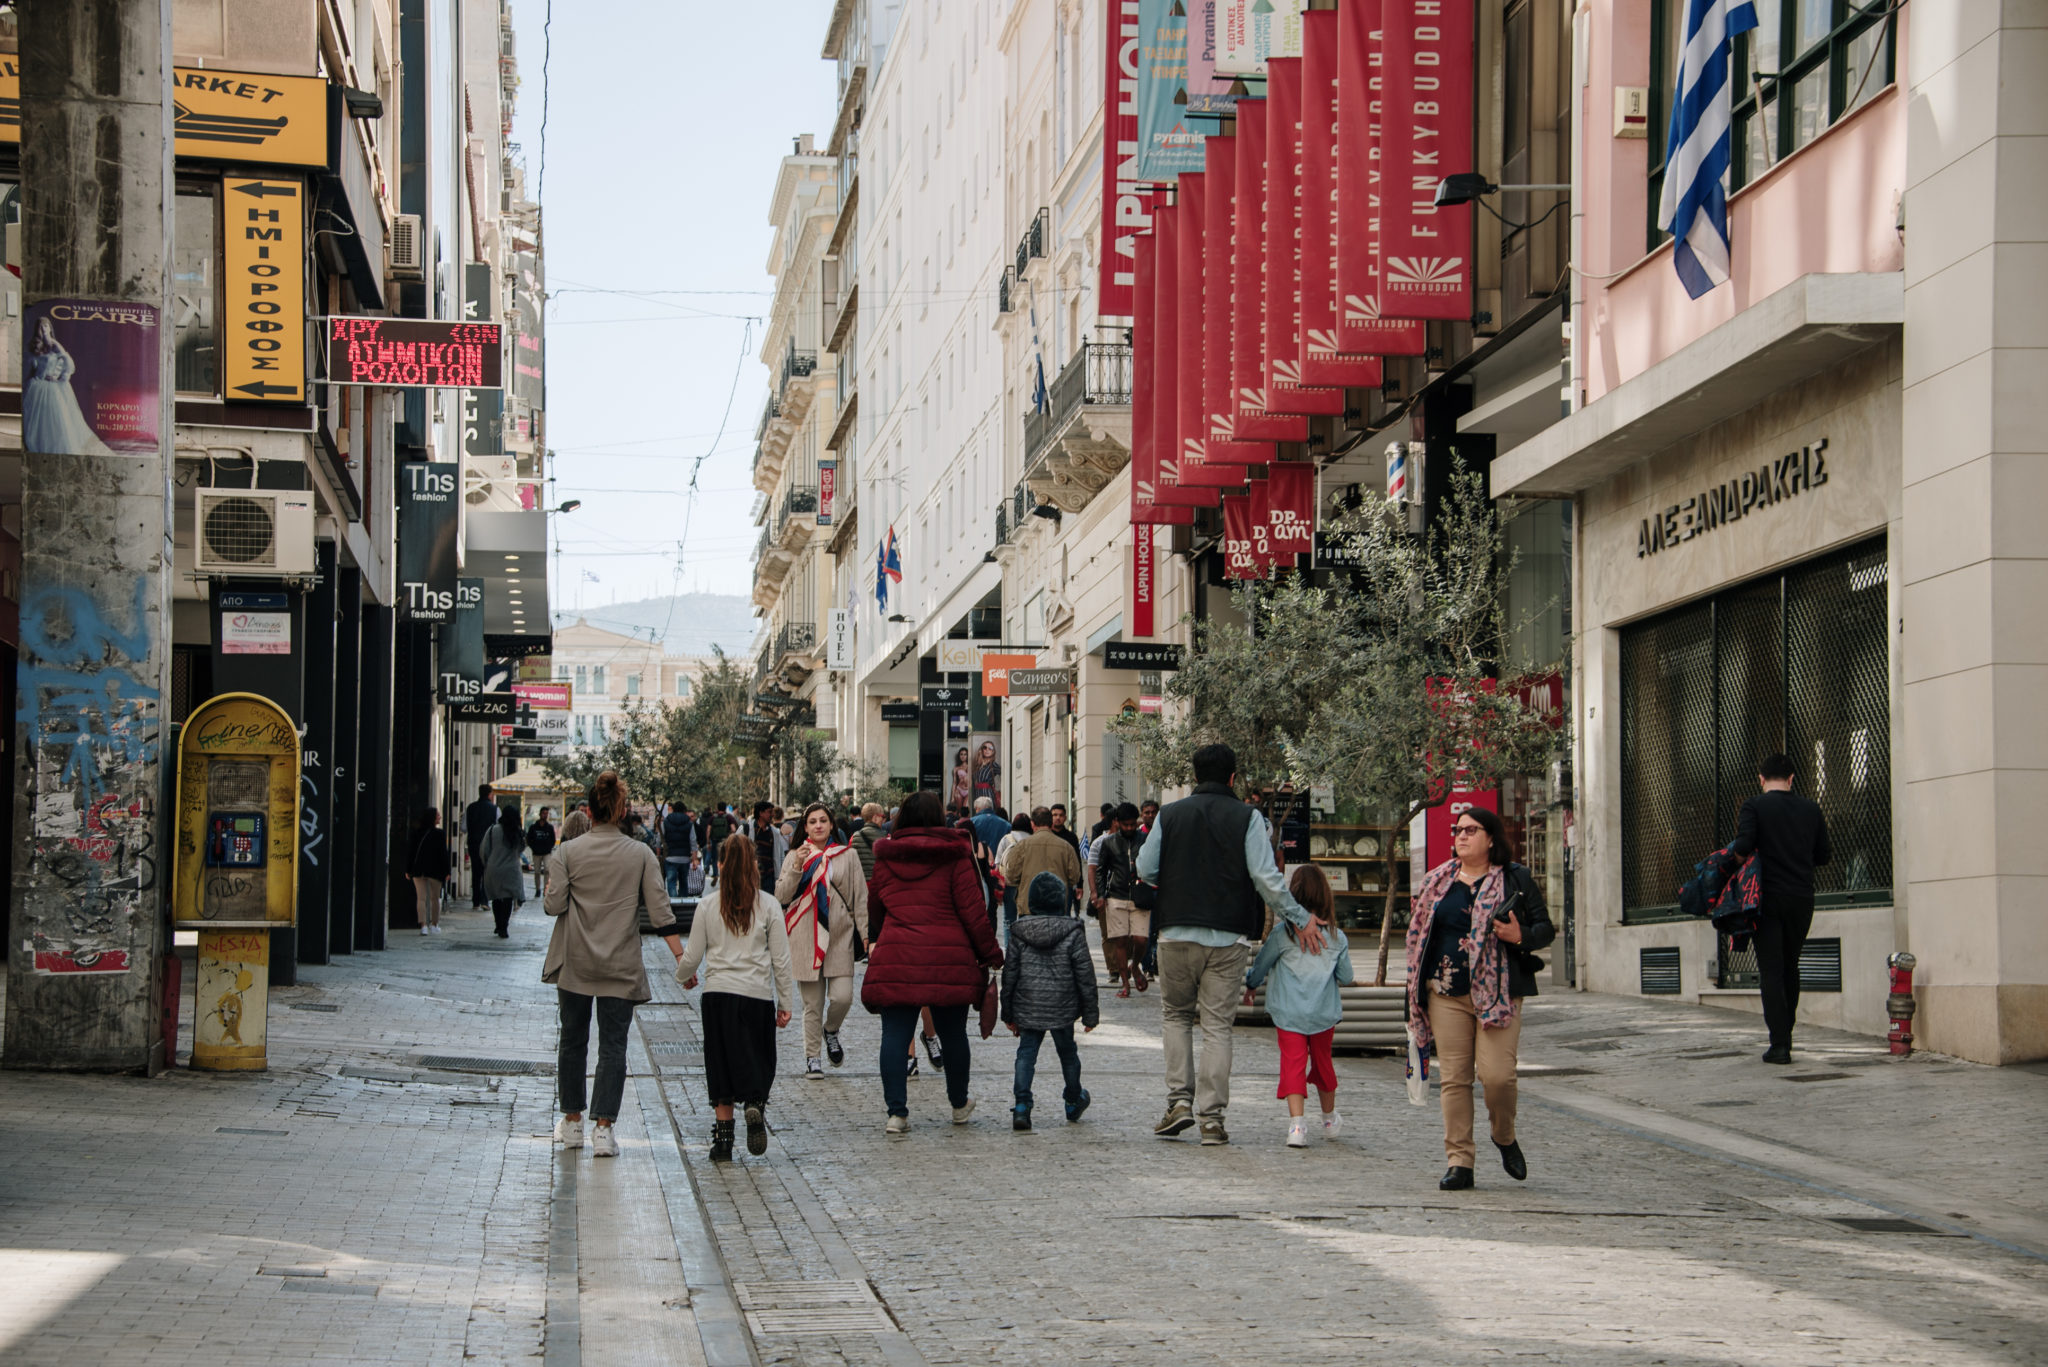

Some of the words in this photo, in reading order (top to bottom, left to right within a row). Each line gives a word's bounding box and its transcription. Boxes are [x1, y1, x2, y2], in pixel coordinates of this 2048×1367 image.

[1202, 1, 1216, 61] Pyramis
[1228, 6, 1236, 52] ΕΞΩΤΙΚΕΣ
[1263, 15, 1271, 59] ΙΝΗΤΡΩΝ
[174, 74, 284, 104] RKET
[246, 207, 283, 371] ΗΜΙΟΡΟΦΟΣ
[1387, 282, 1462, 292] FUNKYBUDDHA
[50, 305, 157, 327] CLAIRE
[351, 361, 482, 387] ΡΟΛΟΓΙΩΝ
[405, 465, 455, 493] Ths
[412, 492, 448, 502] fashion
[1637, 438, 1829, 559] ΑΛΕΞΑΝΔΡΑΚΗΣ
[1138, 523, 1150, 565] HOUSE
[1274, 524, 1311, 540] am
[403, 582, 454, 610] Ths
[457, 580, 481, 602] hs
[1138, 566, 1150, 603] LAPIN
[411, 609, 446, 620] fashion
[836, 612, 845, 662] HOTEL
[440, 672, 481, 696] Ths
[1010, 670, 1068, 686] Cameo's
[446, 694, 475, 702] fashion
[483, 702, 509, 714] ZAC
[529, 690, 566, 701] woman
